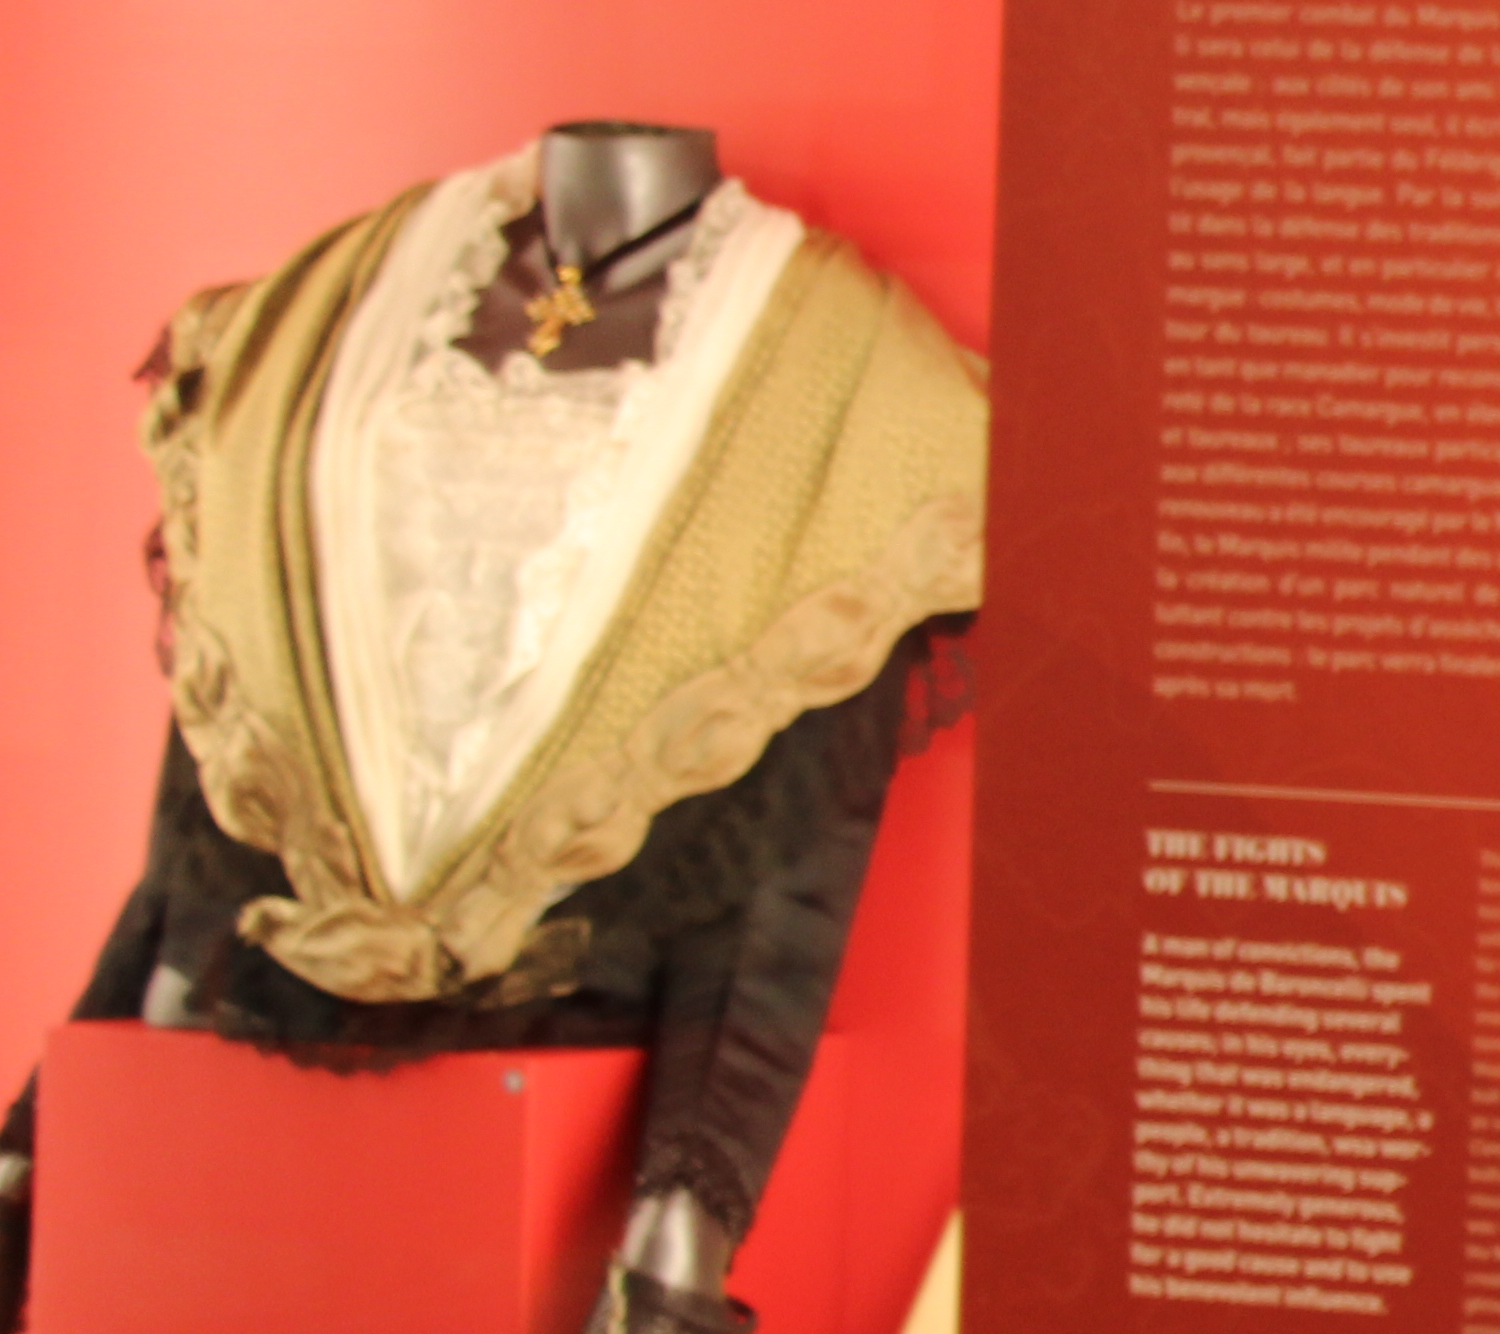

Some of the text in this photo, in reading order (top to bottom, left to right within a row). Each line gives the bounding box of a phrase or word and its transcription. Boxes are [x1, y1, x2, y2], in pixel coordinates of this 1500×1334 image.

[1144, 830, 1326, 864] THE FIGHTS
[1141, 868, 1408, 909] OF THE MARQUIS
